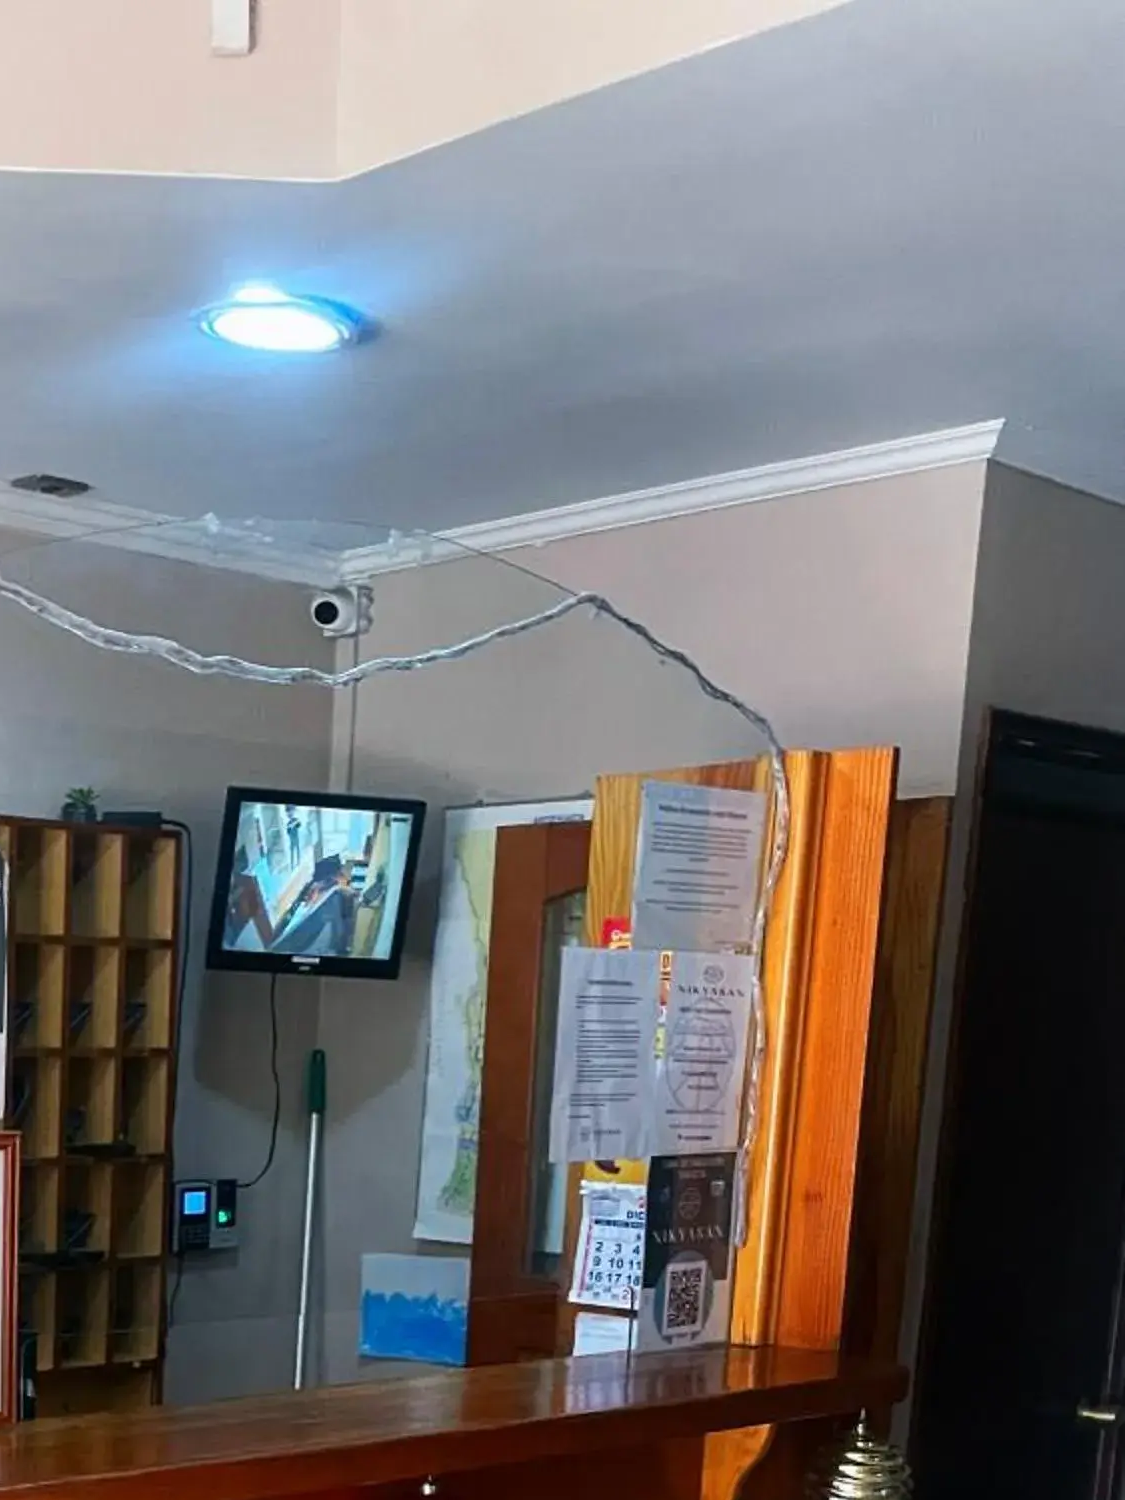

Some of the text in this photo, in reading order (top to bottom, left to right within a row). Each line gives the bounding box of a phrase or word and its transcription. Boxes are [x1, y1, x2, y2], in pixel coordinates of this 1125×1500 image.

[595, 1241, 640, 1255] 2 3 4
[608, 1258, 624, 1269] 10
[589, 1271, 640, 1287] 16 17 18
